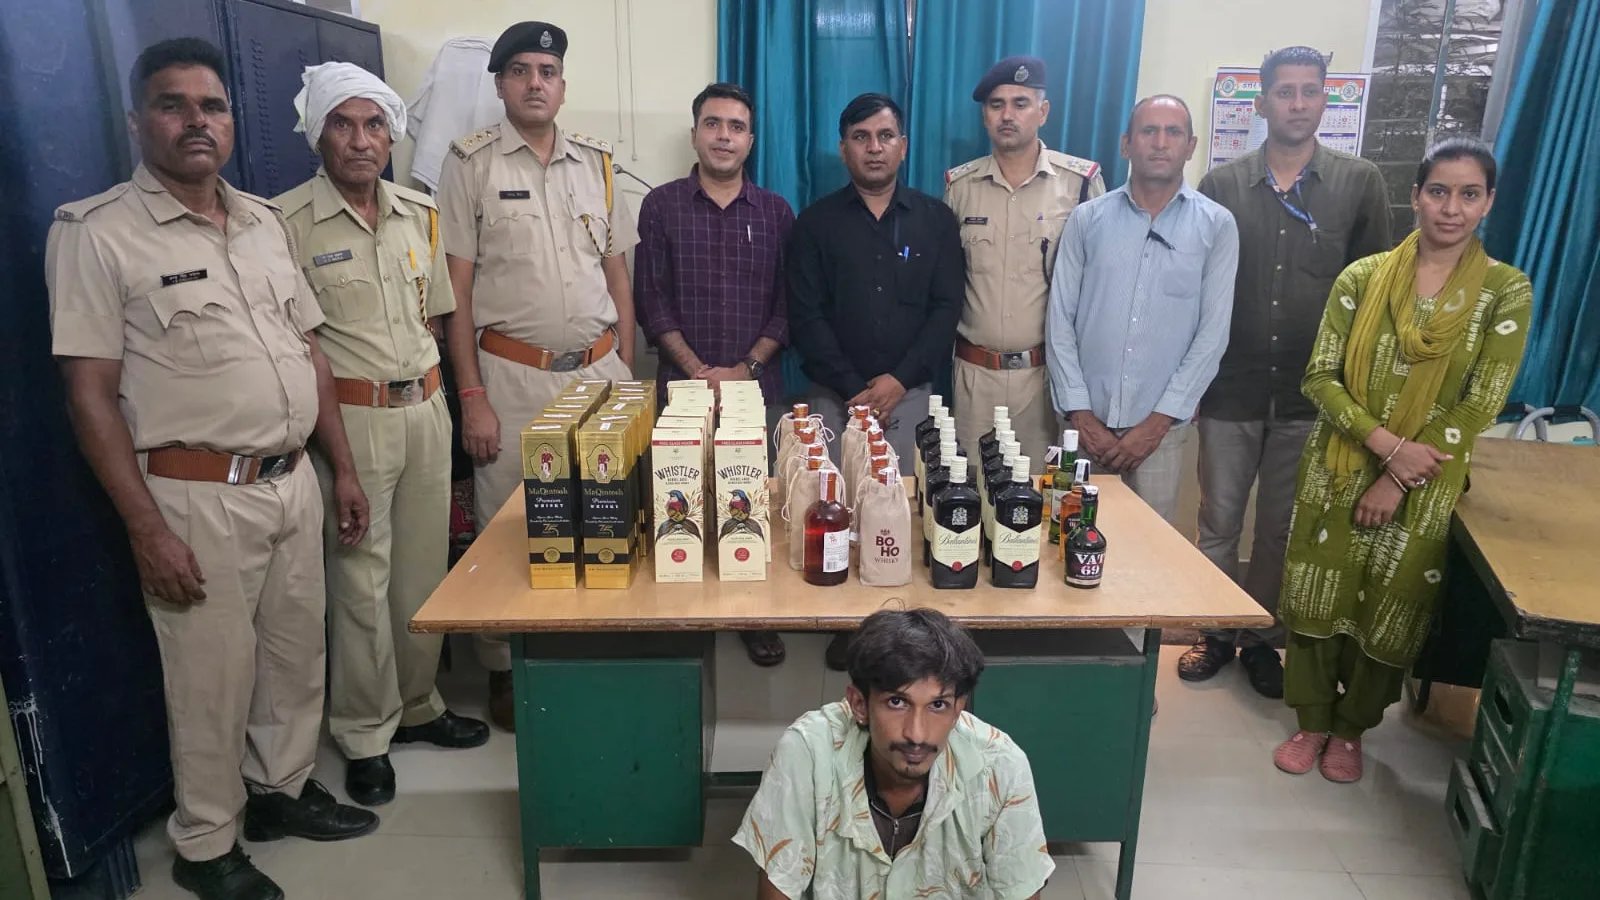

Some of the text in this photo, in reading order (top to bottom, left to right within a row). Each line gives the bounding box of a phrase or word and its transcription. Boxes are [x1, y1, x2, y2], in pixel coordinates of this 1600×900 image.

[655, 465, 700, 480] WHISTLER
[717, 465, 762, 480] WHISTLER
[876, 536, 895, 546] BO
[881, 547, 900, 557] HO
[1080, 565, 1100, 576] 69
